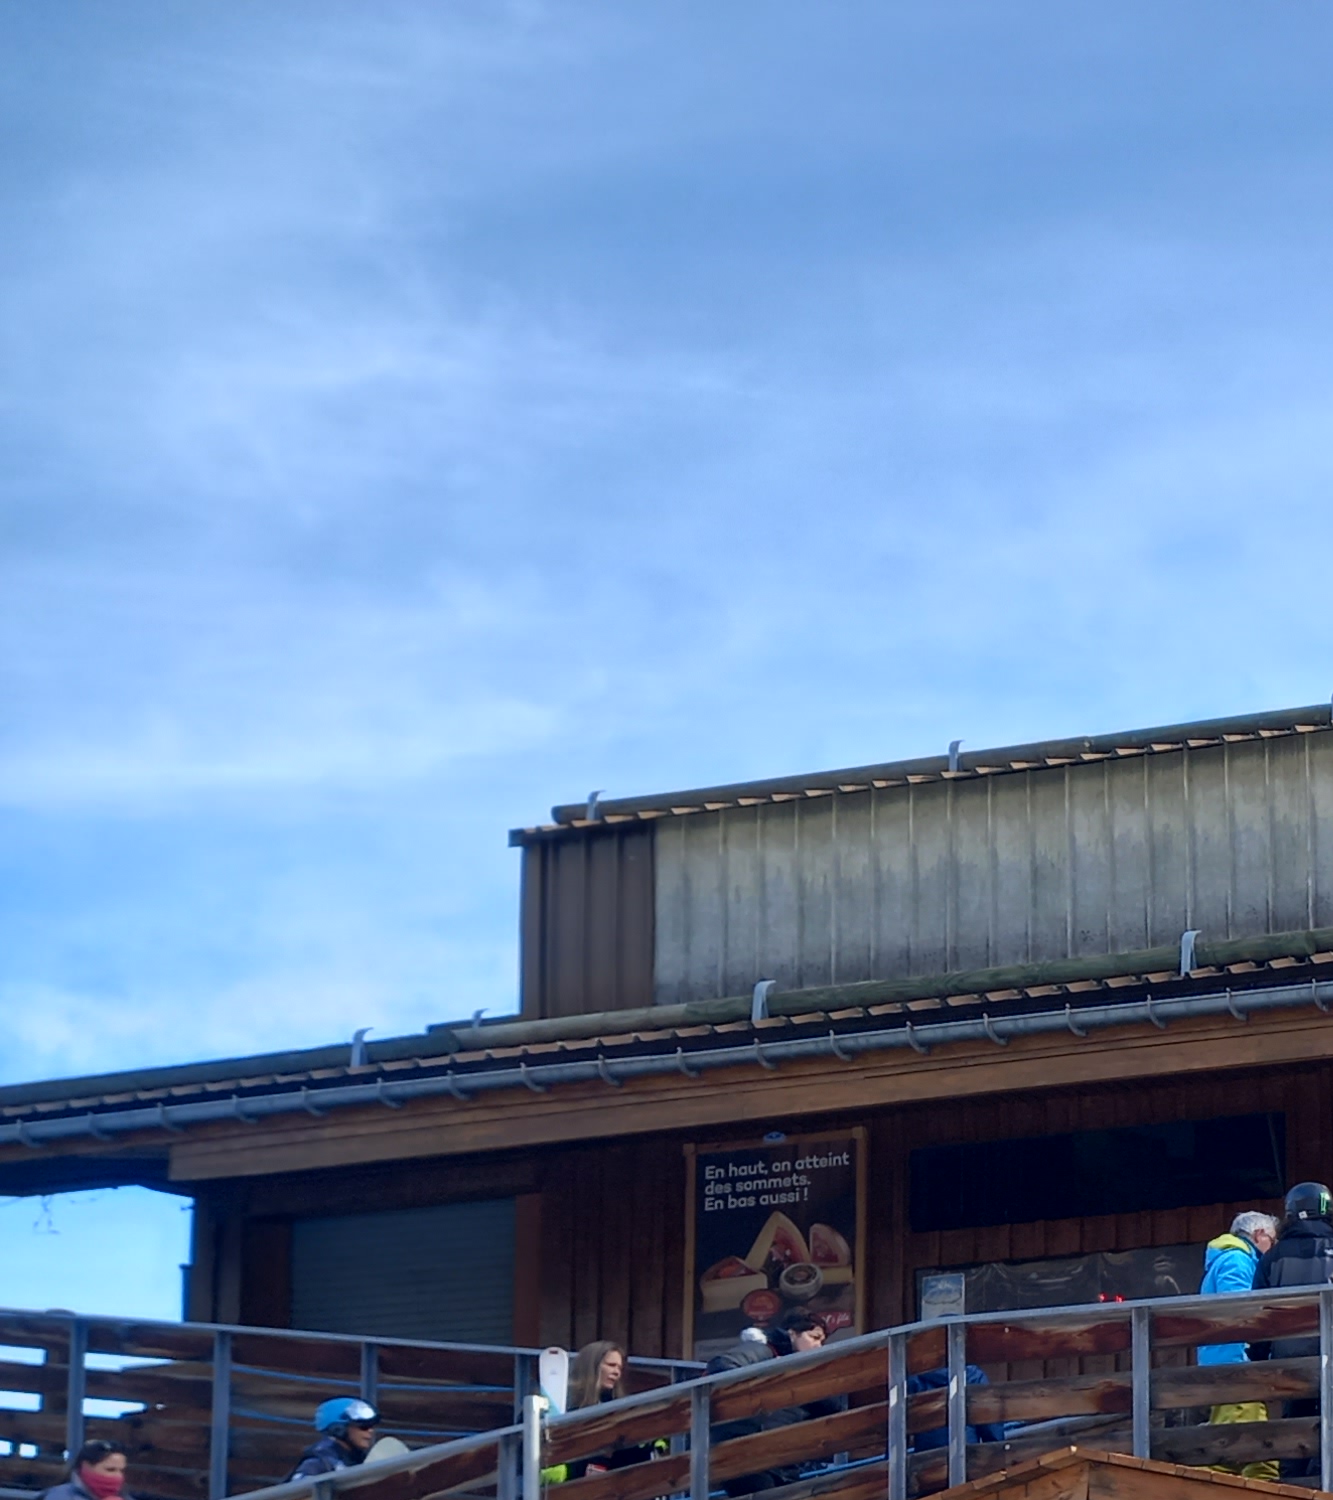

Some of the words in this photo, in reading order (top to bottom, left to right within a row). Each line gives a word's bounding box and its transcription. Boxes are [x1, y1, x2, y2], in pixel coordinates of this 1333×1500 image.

[705, 1165, 724, 1179] En
[728, 1161, 768, 1177] haut,
[772, 1161, 791, 1172] on
[795, 1152, 850, 1170] atteint
[704, 1181, 732, 1195] des
[735, 1173, 811, 1192] sommets.
[704, 1197, 724, 1211] En
[728, 1194, 756, 1209] bas
[759, 1188, 800, 1205] aussi
